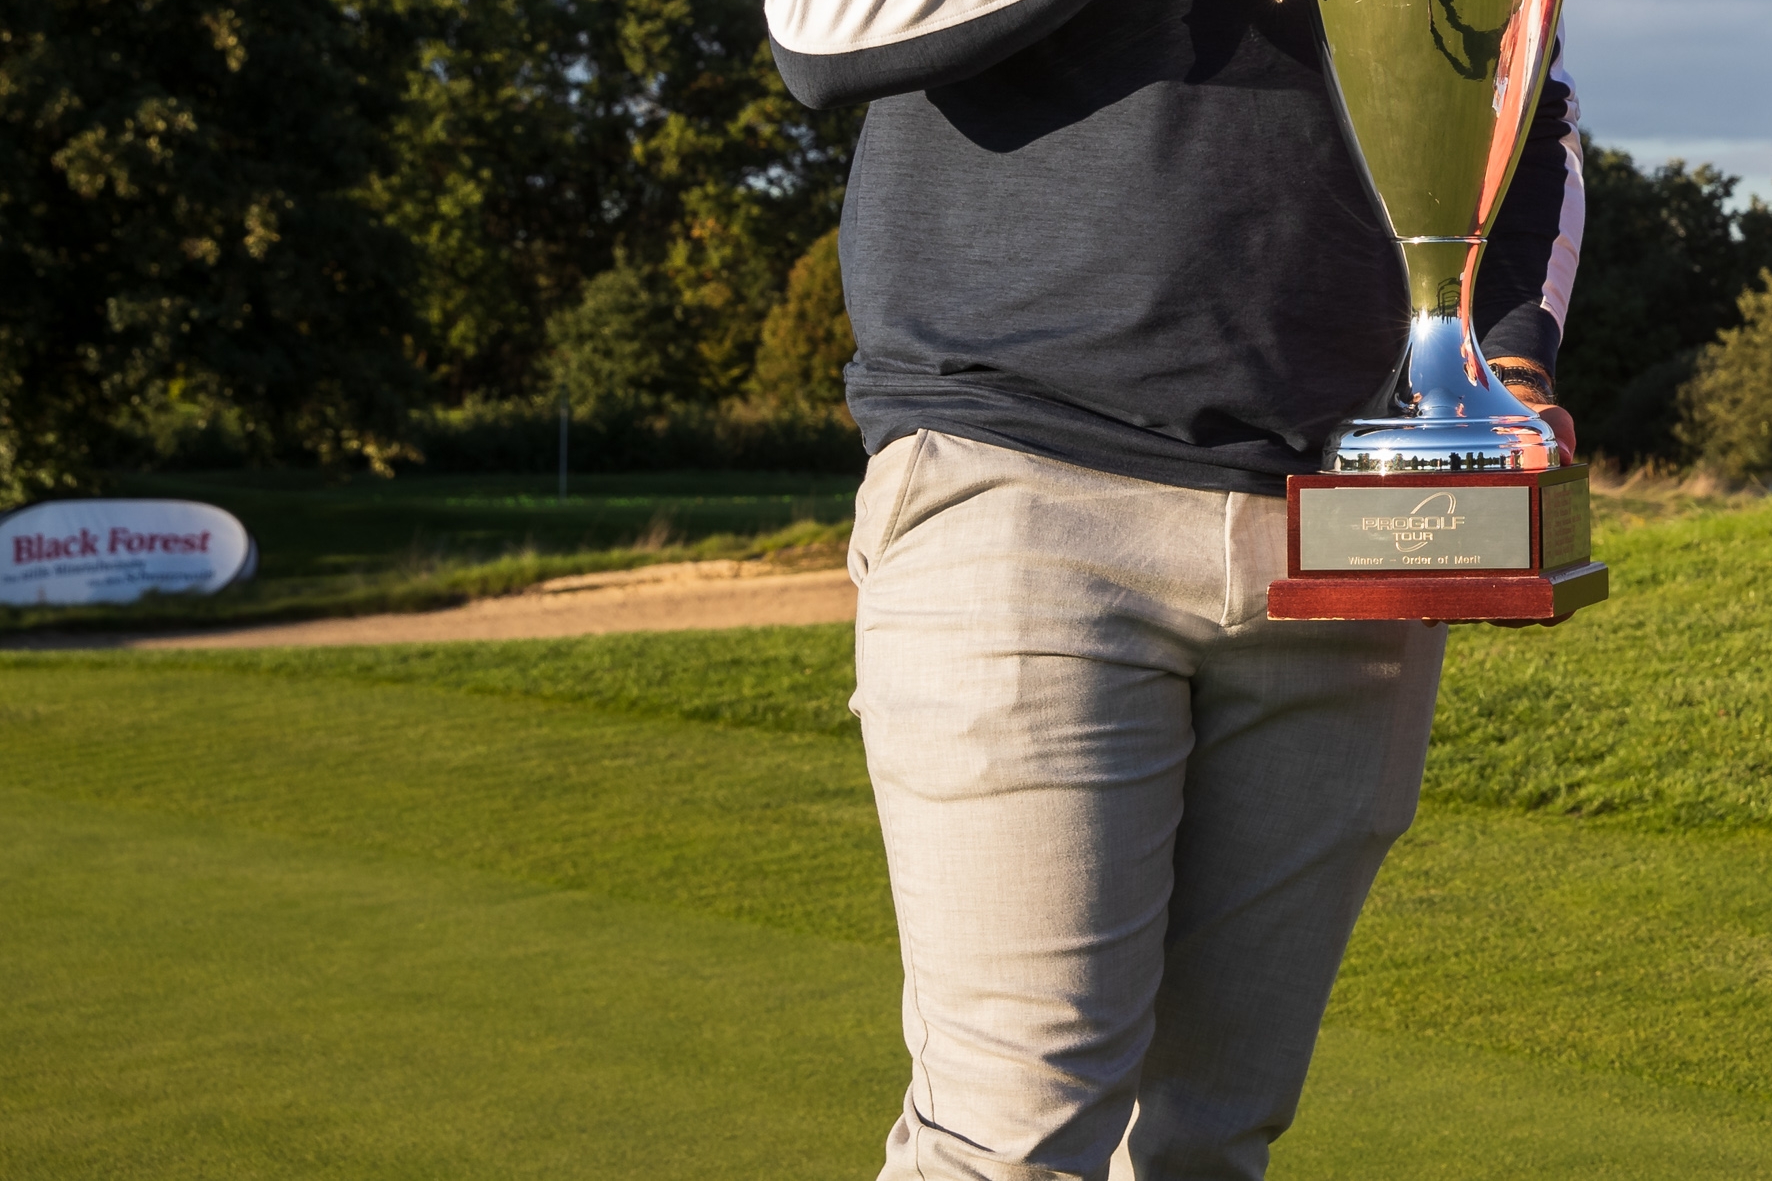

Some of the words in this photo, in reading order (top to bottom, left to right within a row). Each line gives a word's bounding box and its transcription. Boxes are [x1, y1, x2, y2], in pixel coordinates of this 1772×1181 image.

[1362, 516, 1465, 530] PROGOLF
[1393, 532, 1433, 541] TOUR
[13, 527, 98, 565] Black
[107, 526, 212, 555] Forest
[1348, 556, 1384, 565] Winner
[1402, 555, 1432, 565] Order
[1437, 555, 1449, 564] of
[1454, 555, 1481, 564] Merit
